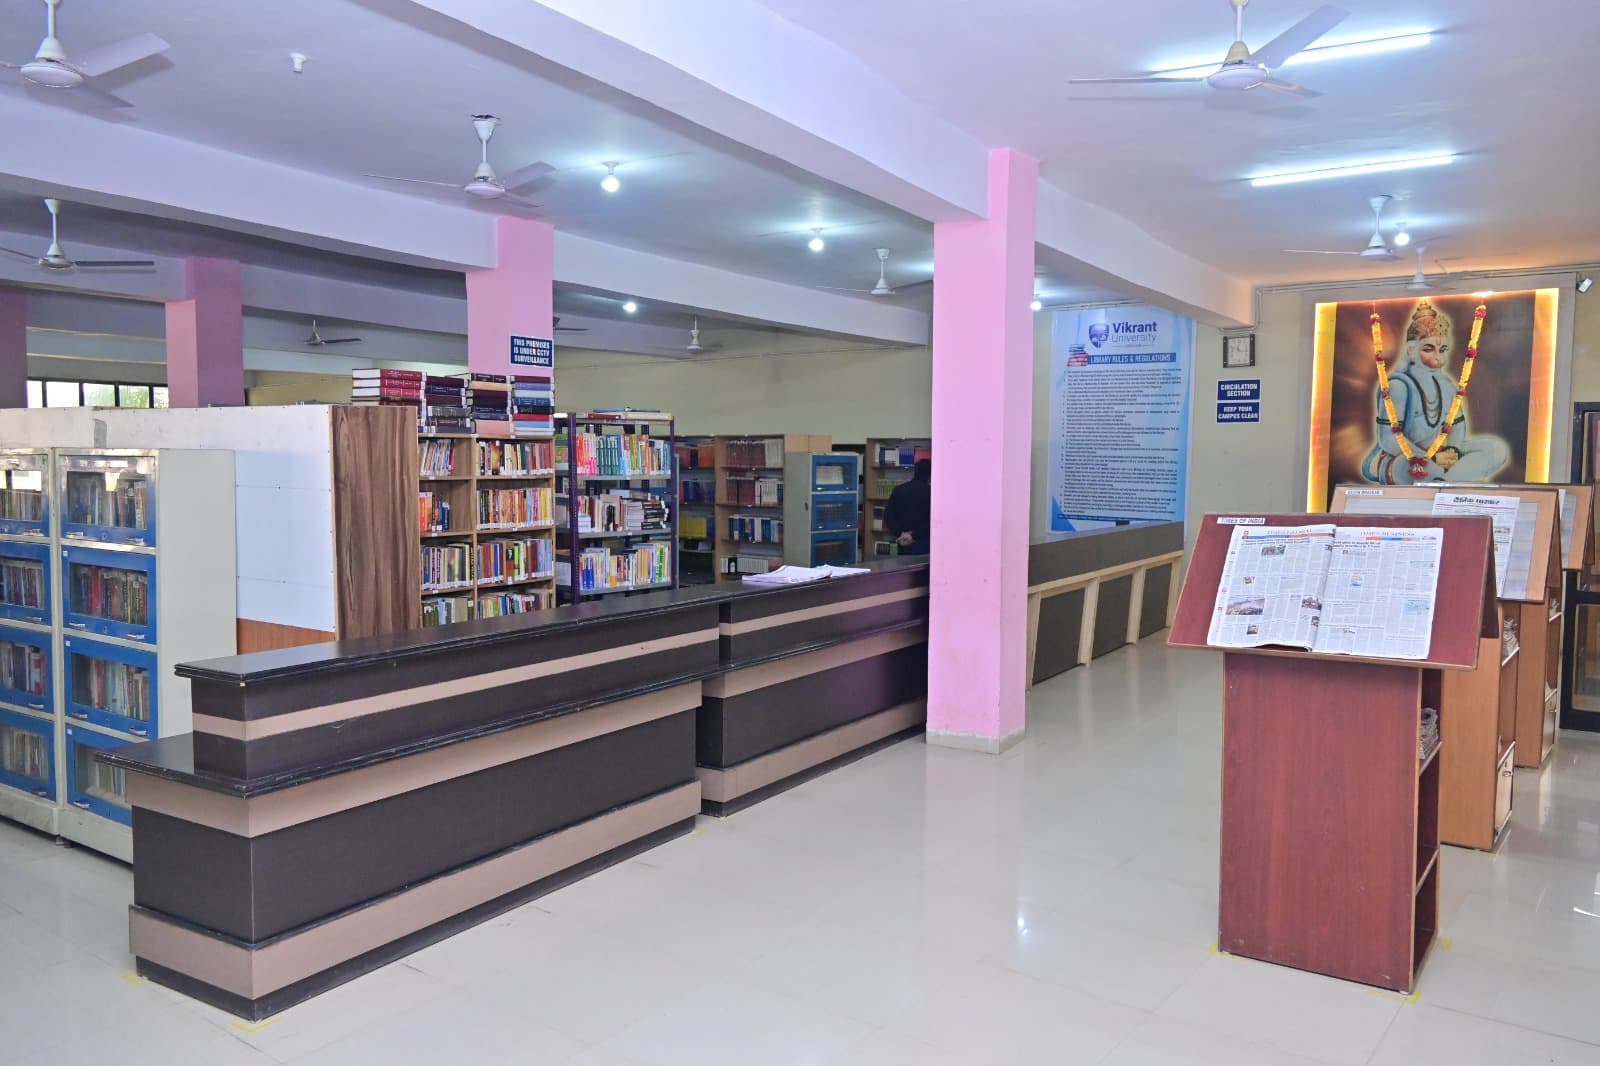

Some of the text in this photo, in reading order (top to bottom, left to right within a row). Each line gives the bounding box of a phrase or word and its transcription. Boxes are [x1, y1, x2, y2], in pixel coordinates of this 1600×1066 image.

[1112, 321, 1157, 333] Vikrant
[513, 338, 525, 346] THIS
[1111, 333, 1157, 343] University
[519, 347, 537, 356] UNDER
[537, 348, 550, 357] CCTV
[514, 354, 549, 365] SURVEILLANCE
[1091, 355, 1112, 363] LIBRARY
[1112, 355, 1129, 363] RULES
[1135, 353, 1171, 362] REGULATIONS
[1220, 383, 1258, 391] CIRCULATION
